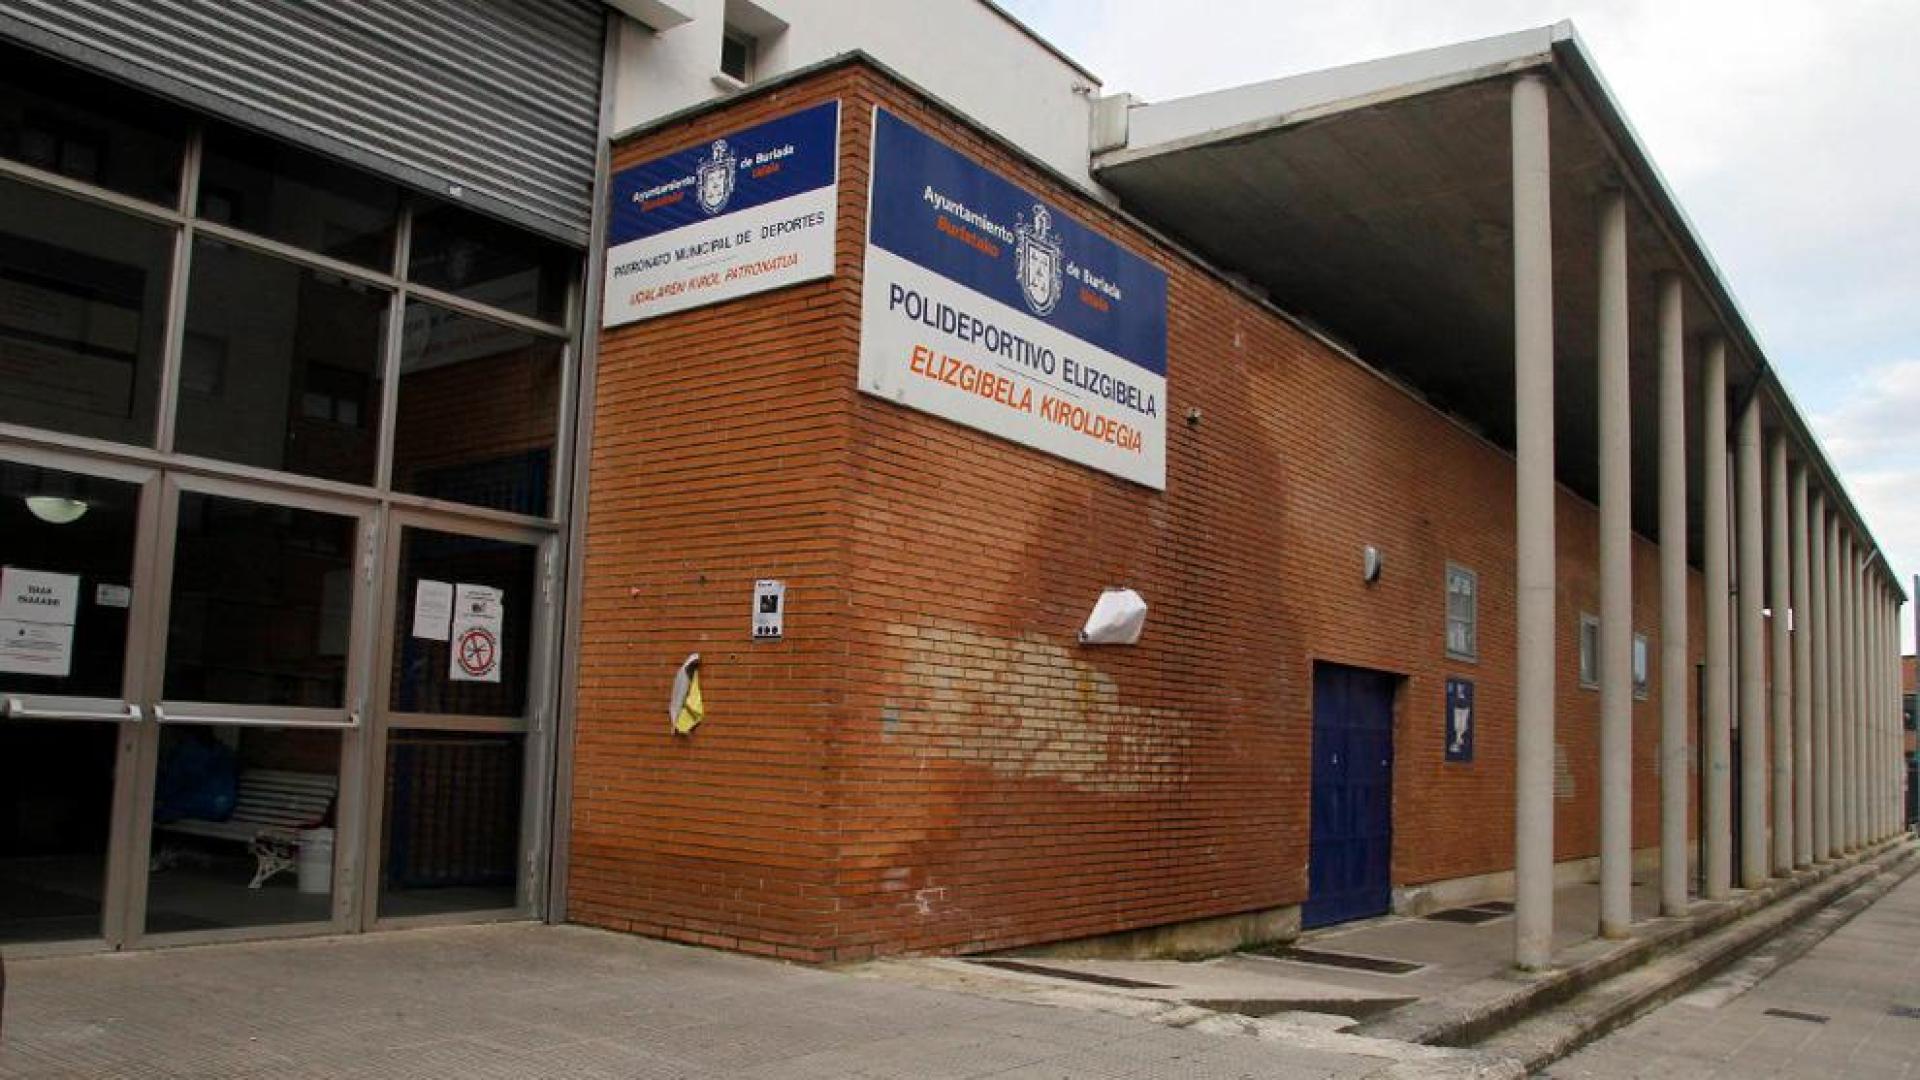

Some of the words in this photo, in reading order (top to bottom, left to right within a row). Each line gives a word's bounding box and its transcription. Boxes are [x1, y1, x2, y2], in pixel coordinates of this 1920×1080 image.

[613, 252, 672, 279] PATRONATO
[674, 236, 732, 263] MUNICIPAL
[736, 230, 752, 245] DE
[760, 211, 826, 240] DEPORTES
[724, 252, 799, 284] PATRONATUA
[923, 184, 1015, 245] Ayuntamiento
[1065, 260, 1082, 279] de
[888, 282, 1056, 376] POLIDEPORTIVO
[1062, 357, 1158, 420] ELIZGIBELA
[909, 344, 1033, 414] ELIZGIBELA
[1039, 394, 1143, 455] KIROLDEGIA
